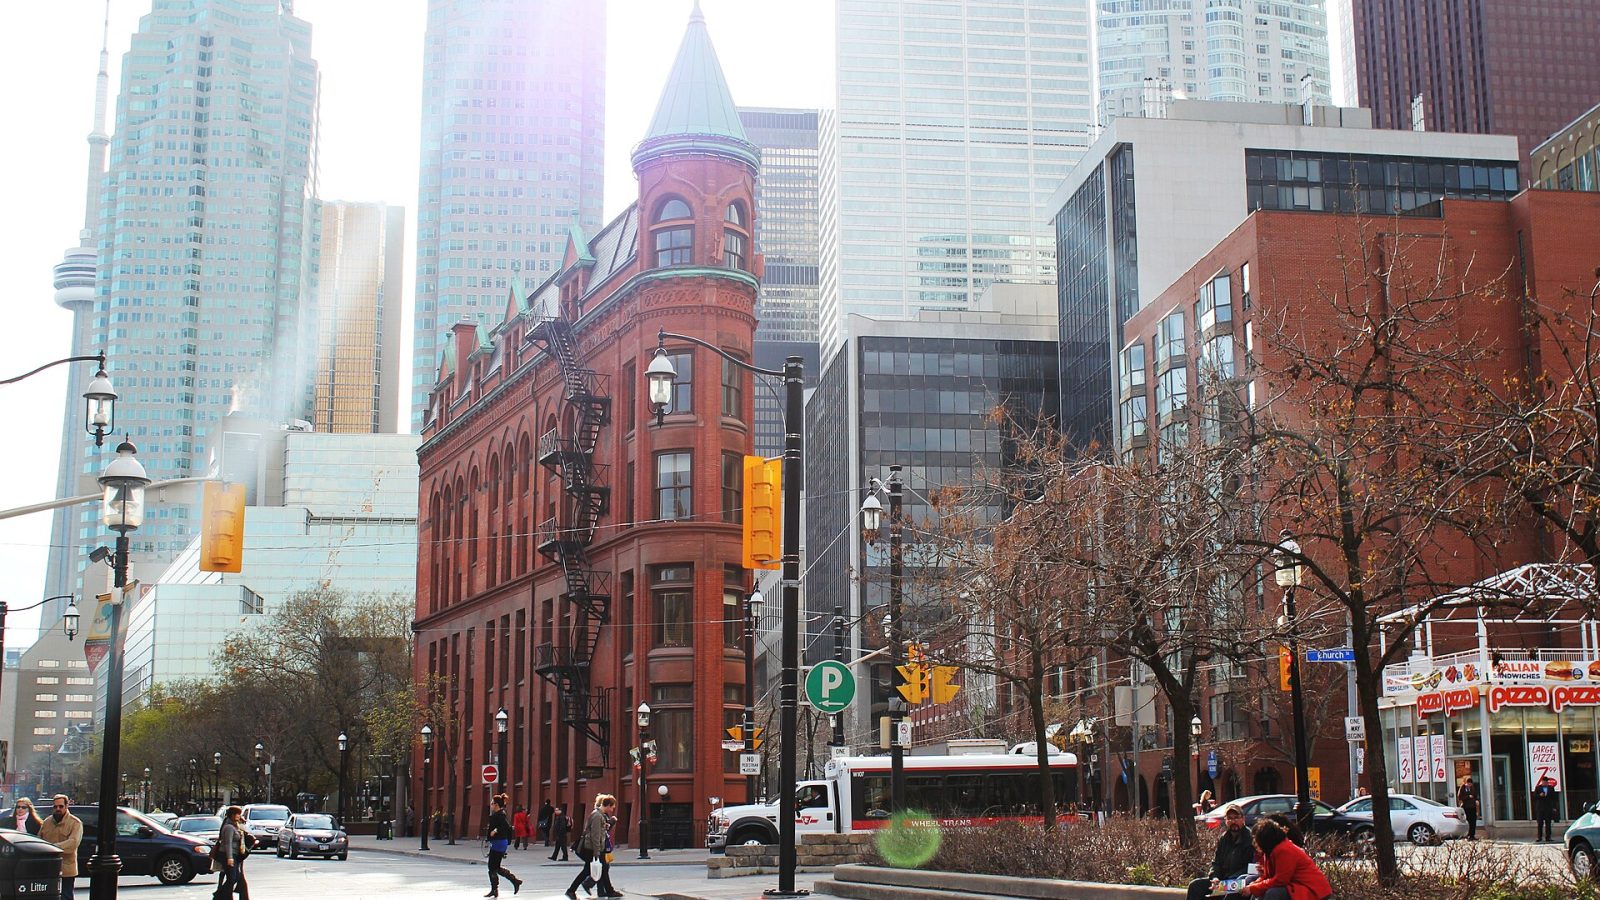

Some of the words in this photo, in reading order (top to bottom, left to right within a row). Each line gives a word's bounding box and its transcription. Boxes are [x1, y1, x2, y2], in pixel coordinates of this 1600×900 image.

[1318, 651, 1344, 659] Church
[1492, 662, 1539, 672] IALIAN
[822, 666, 842, 698] P
[1491, 686, 1548, 712] pizza
[1532, 745, 1555, 753] LARGE
[1533, 754, 1556, 762] PIZZA
[30, 883, 48, 892] Litter
